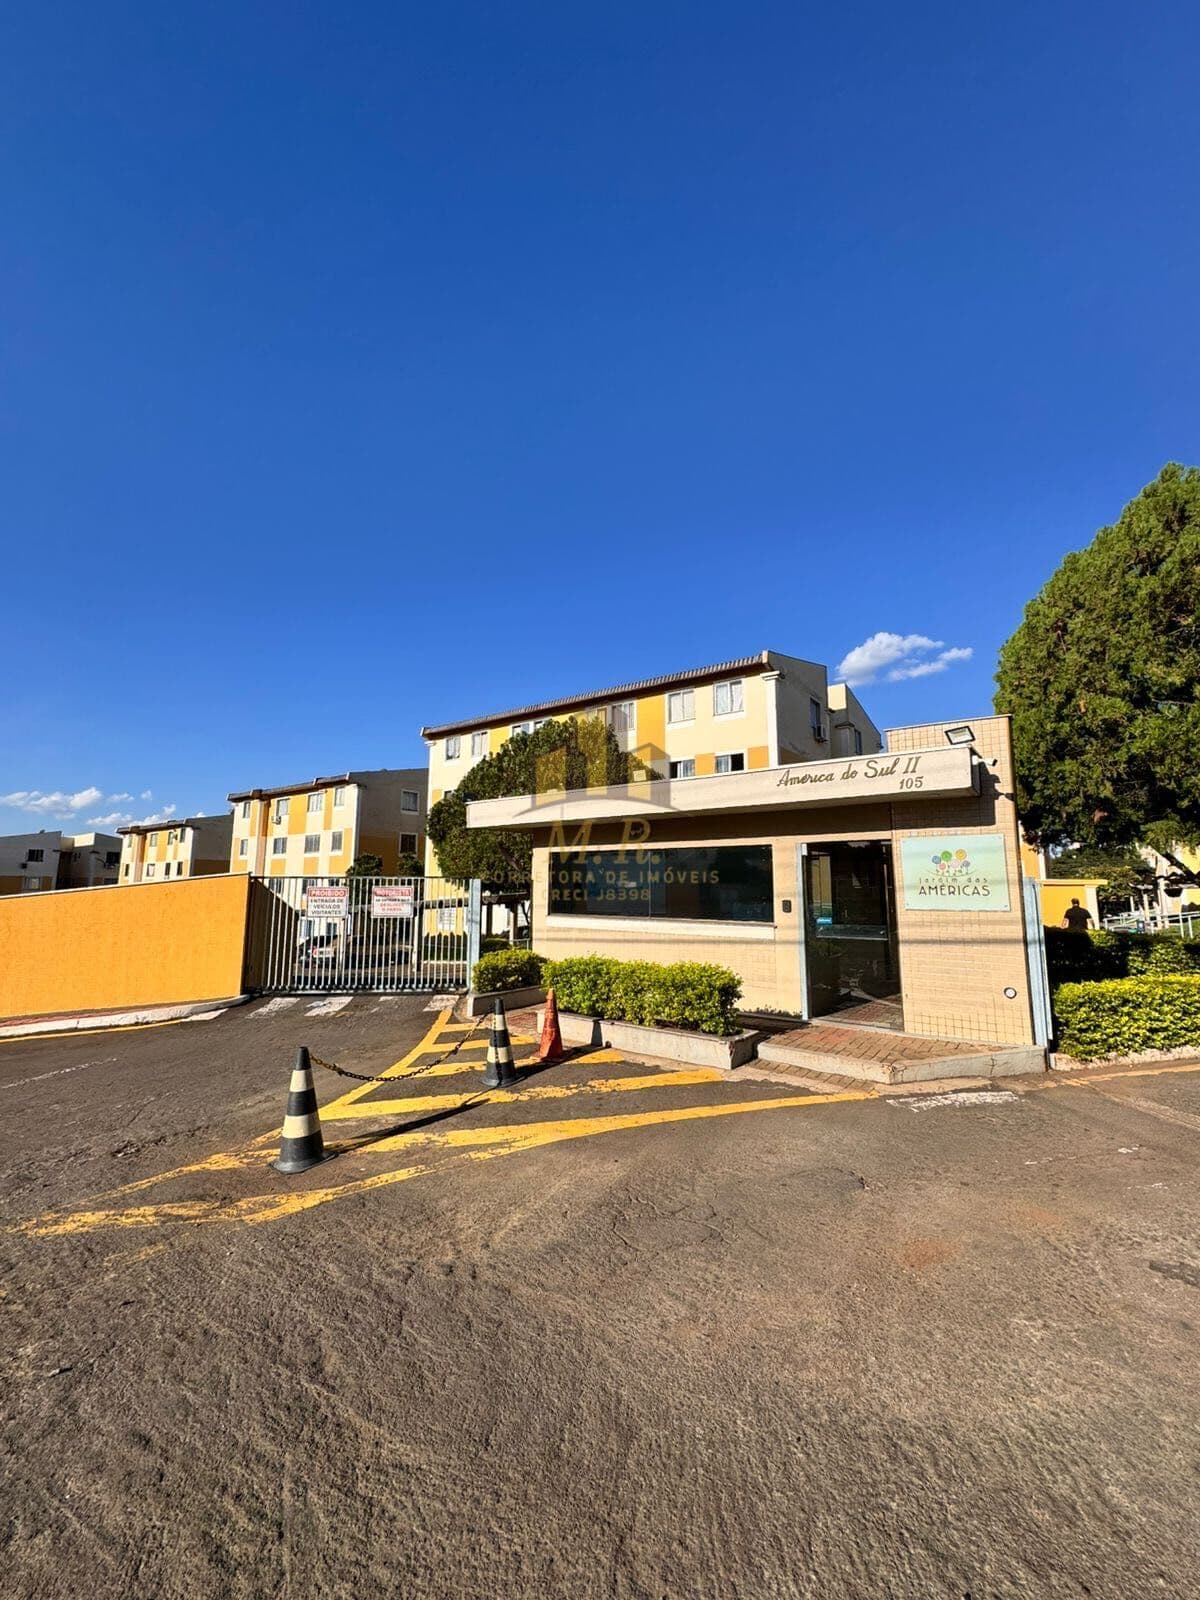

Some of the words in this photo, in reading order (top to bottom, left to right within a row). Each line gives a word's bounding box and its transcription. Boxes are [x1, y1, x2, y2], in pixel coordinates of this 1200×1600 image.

[864, 757, 900, 778] Sul
[903, 756, 921, 774] II
[899, 776, 924, 790] 105
